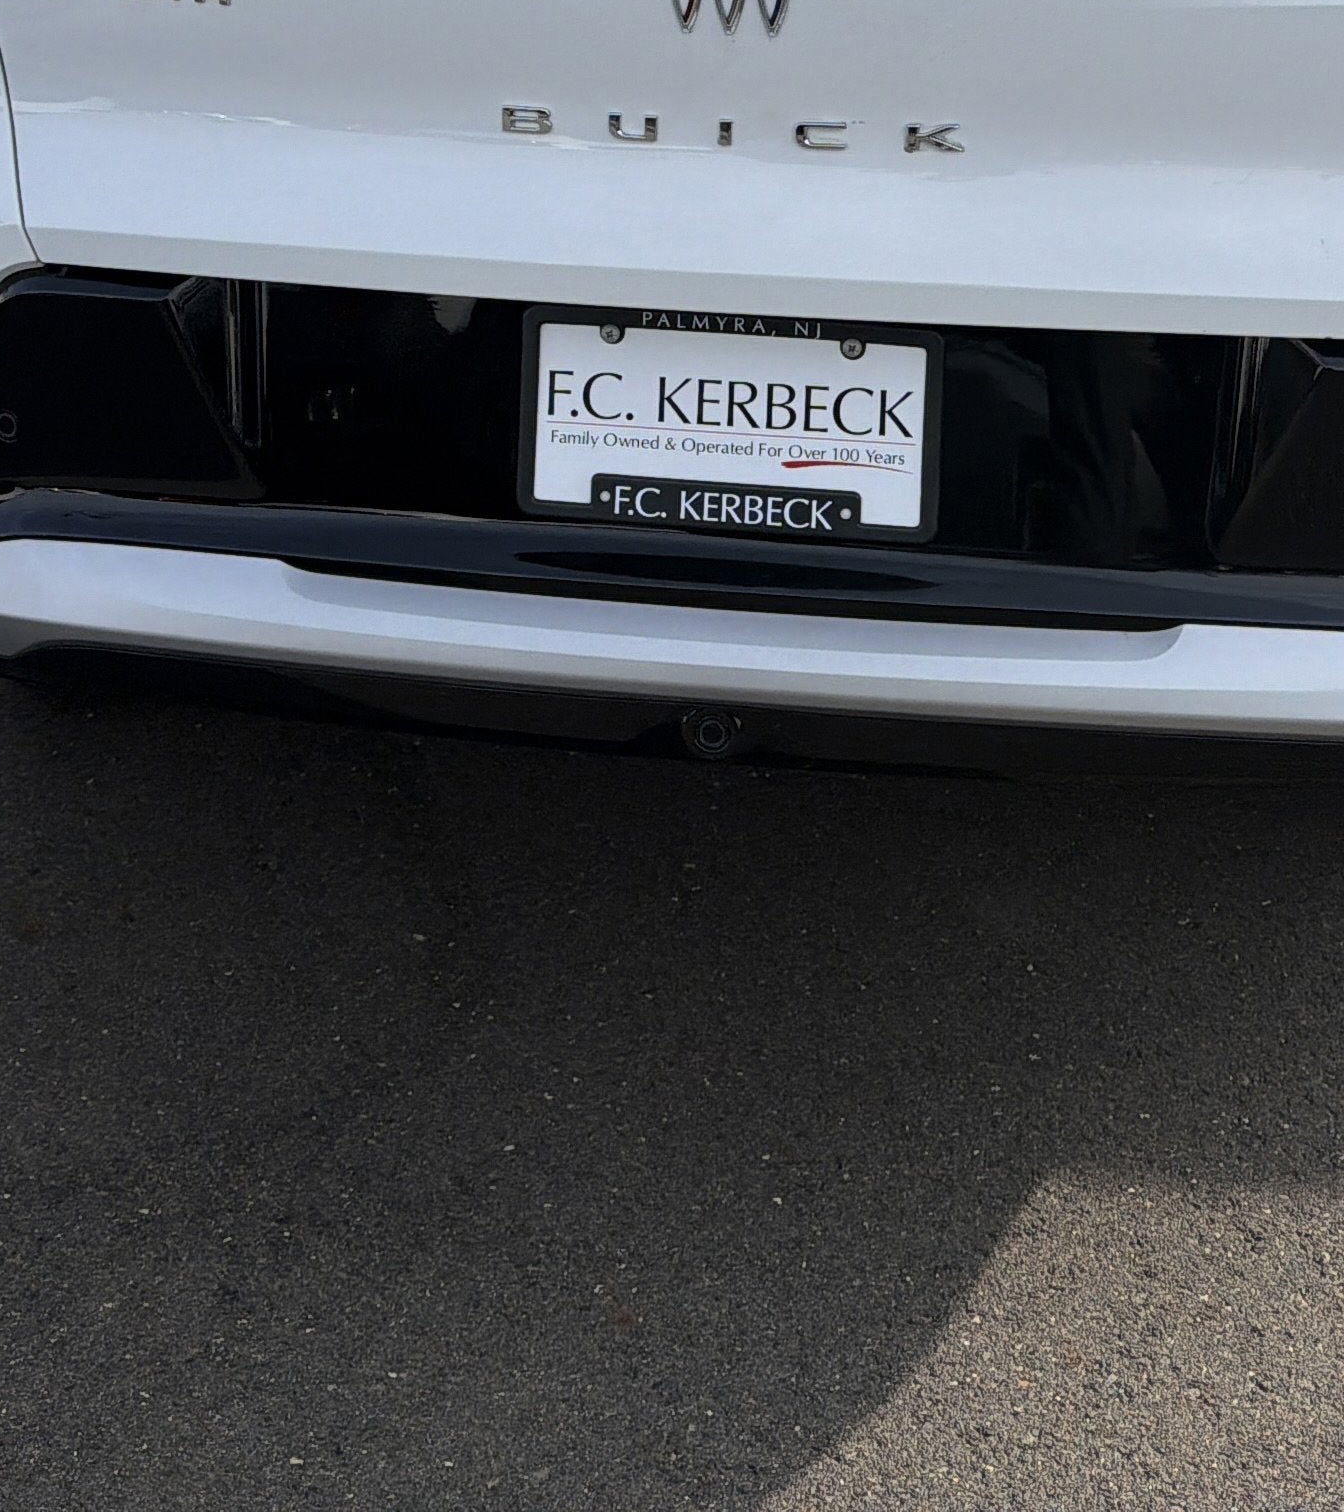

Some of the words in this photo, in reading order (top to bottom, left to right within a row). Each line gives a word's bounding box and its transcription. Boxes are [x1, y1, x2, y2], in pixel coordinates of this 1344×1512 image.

[501, 103, 965, 154] BUICK
[641, 311, 776, 337] PALMYRA,
[794, 320, 821, 339] NJ
[547, 369, 634, 421] F.C.
[657, 376, 914, 438] KERBECK
[550, 429, 599, 448] Family
[603, 432, 660, 450] Owned
[664, 437, 676, 451] &
[681, 437, 754, 456] Operated
[758, 442, 783, 458] For
[788, 444, 826, 460] Over
[831, 447, 860, 462] 100
[866, 449, 905, 465] Years
[613, 485, 667, 518] F.C.
[679, 490, 833, 531] KERBECK
